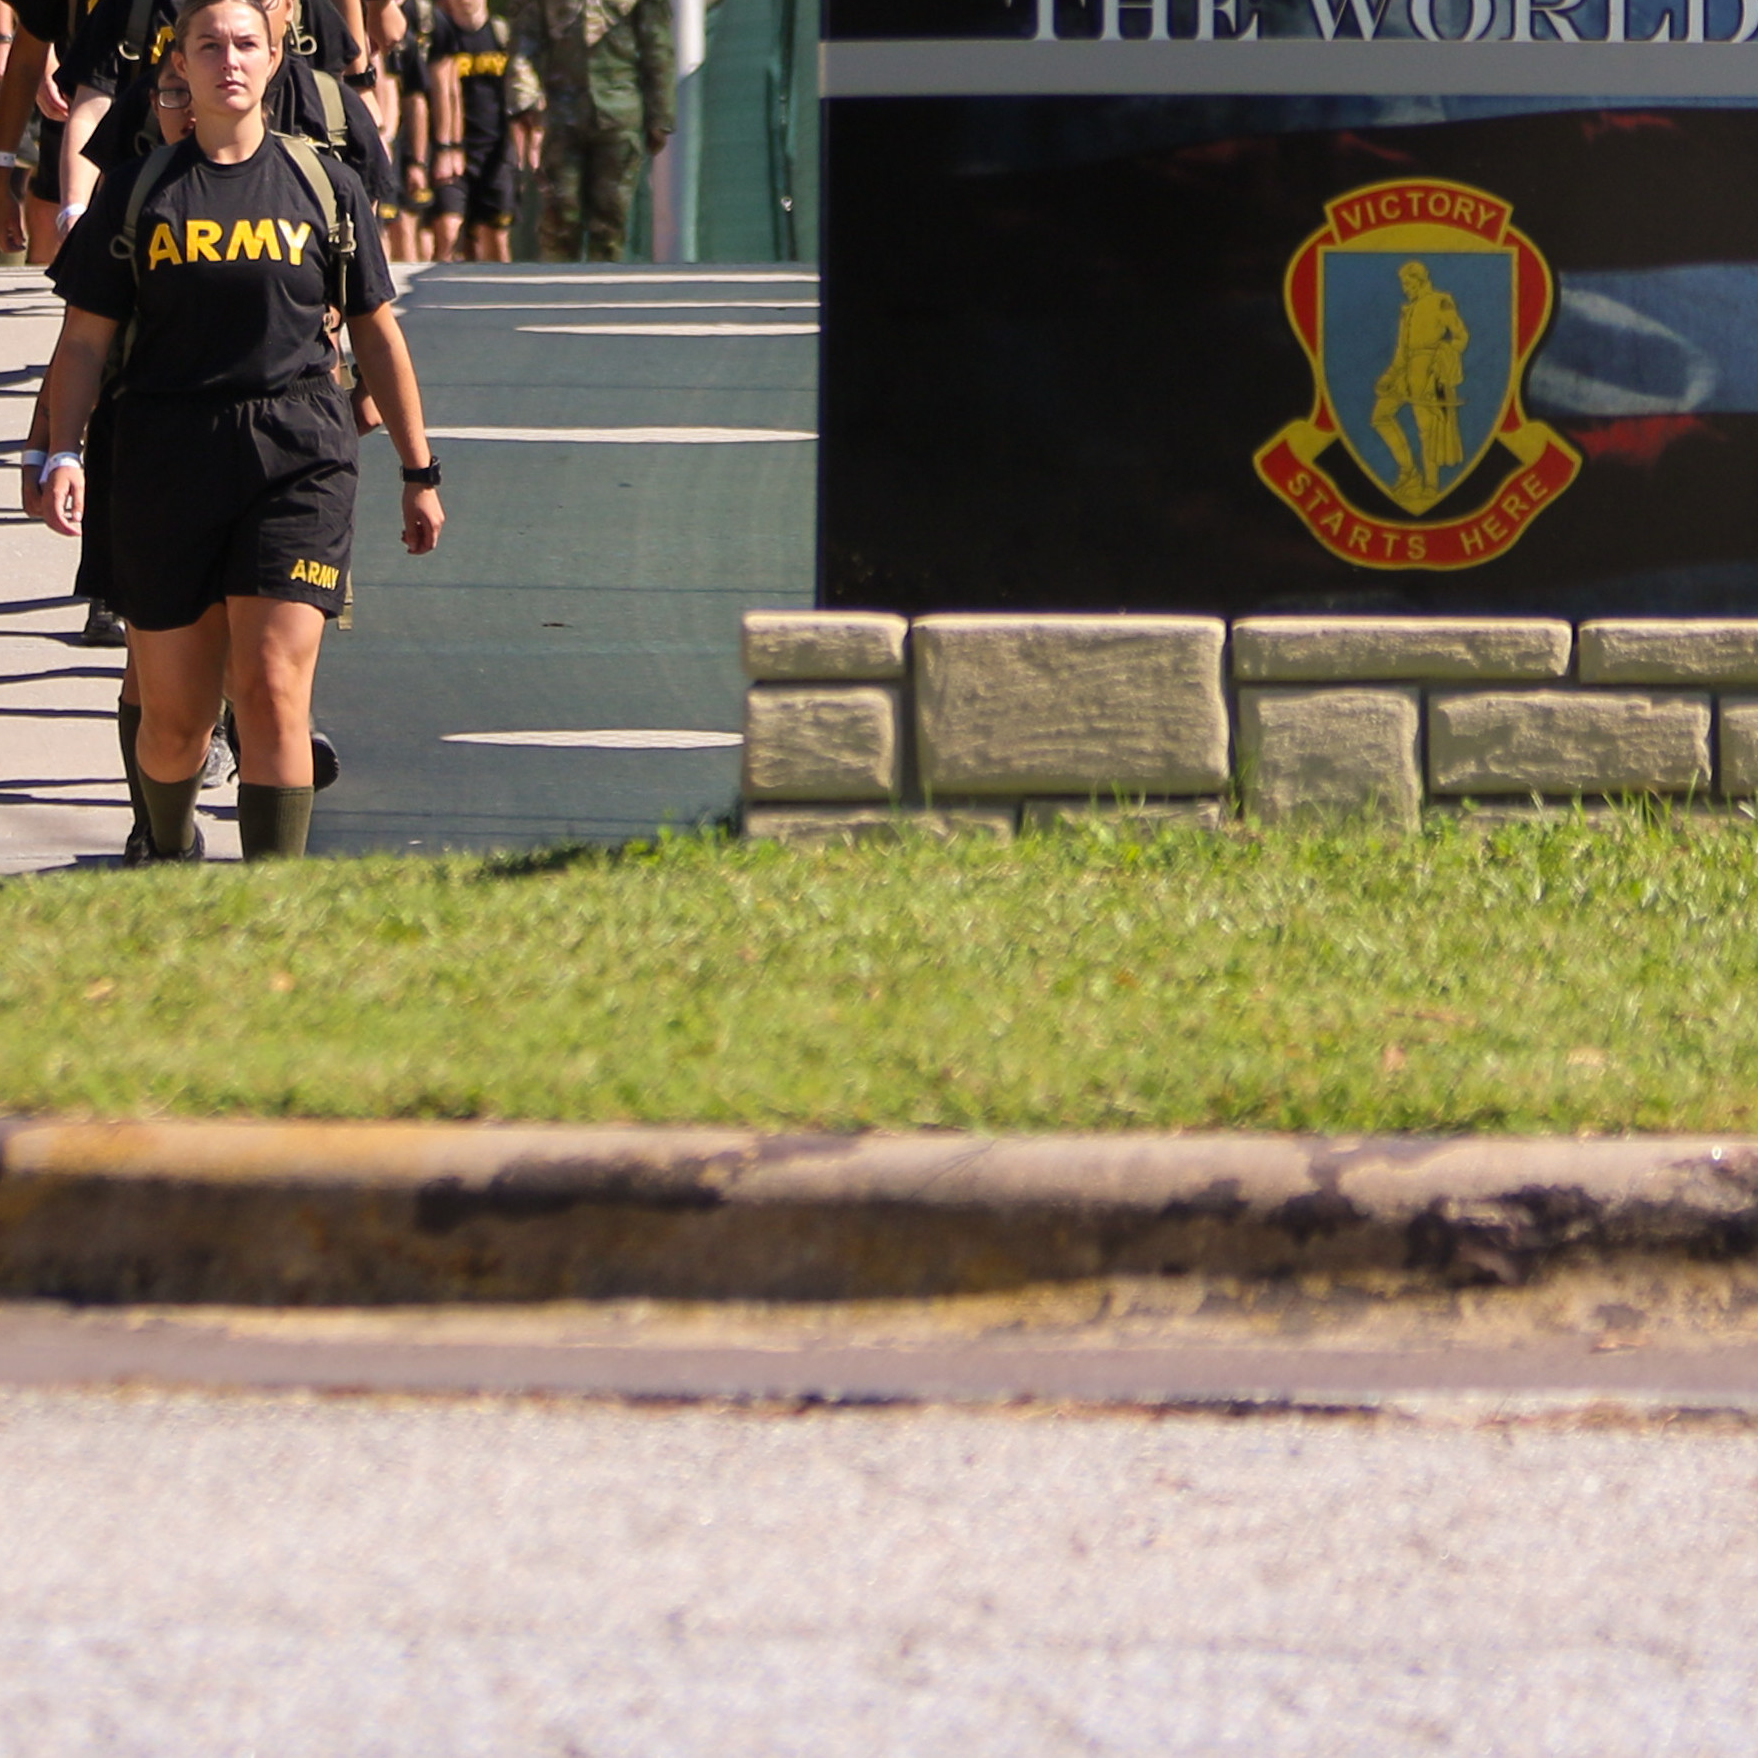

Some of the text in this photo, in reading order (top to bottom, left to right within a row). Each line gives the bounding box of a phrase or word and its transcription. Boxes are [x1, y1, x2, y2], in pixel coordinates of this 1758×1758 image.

[1341, 191, 1497, 231] VICTORY
[148, 218, 312, 270] ARMY
[1287, 471, 1549, 561] STARTS HERE
[290, 558, 340, 590] ARMY
